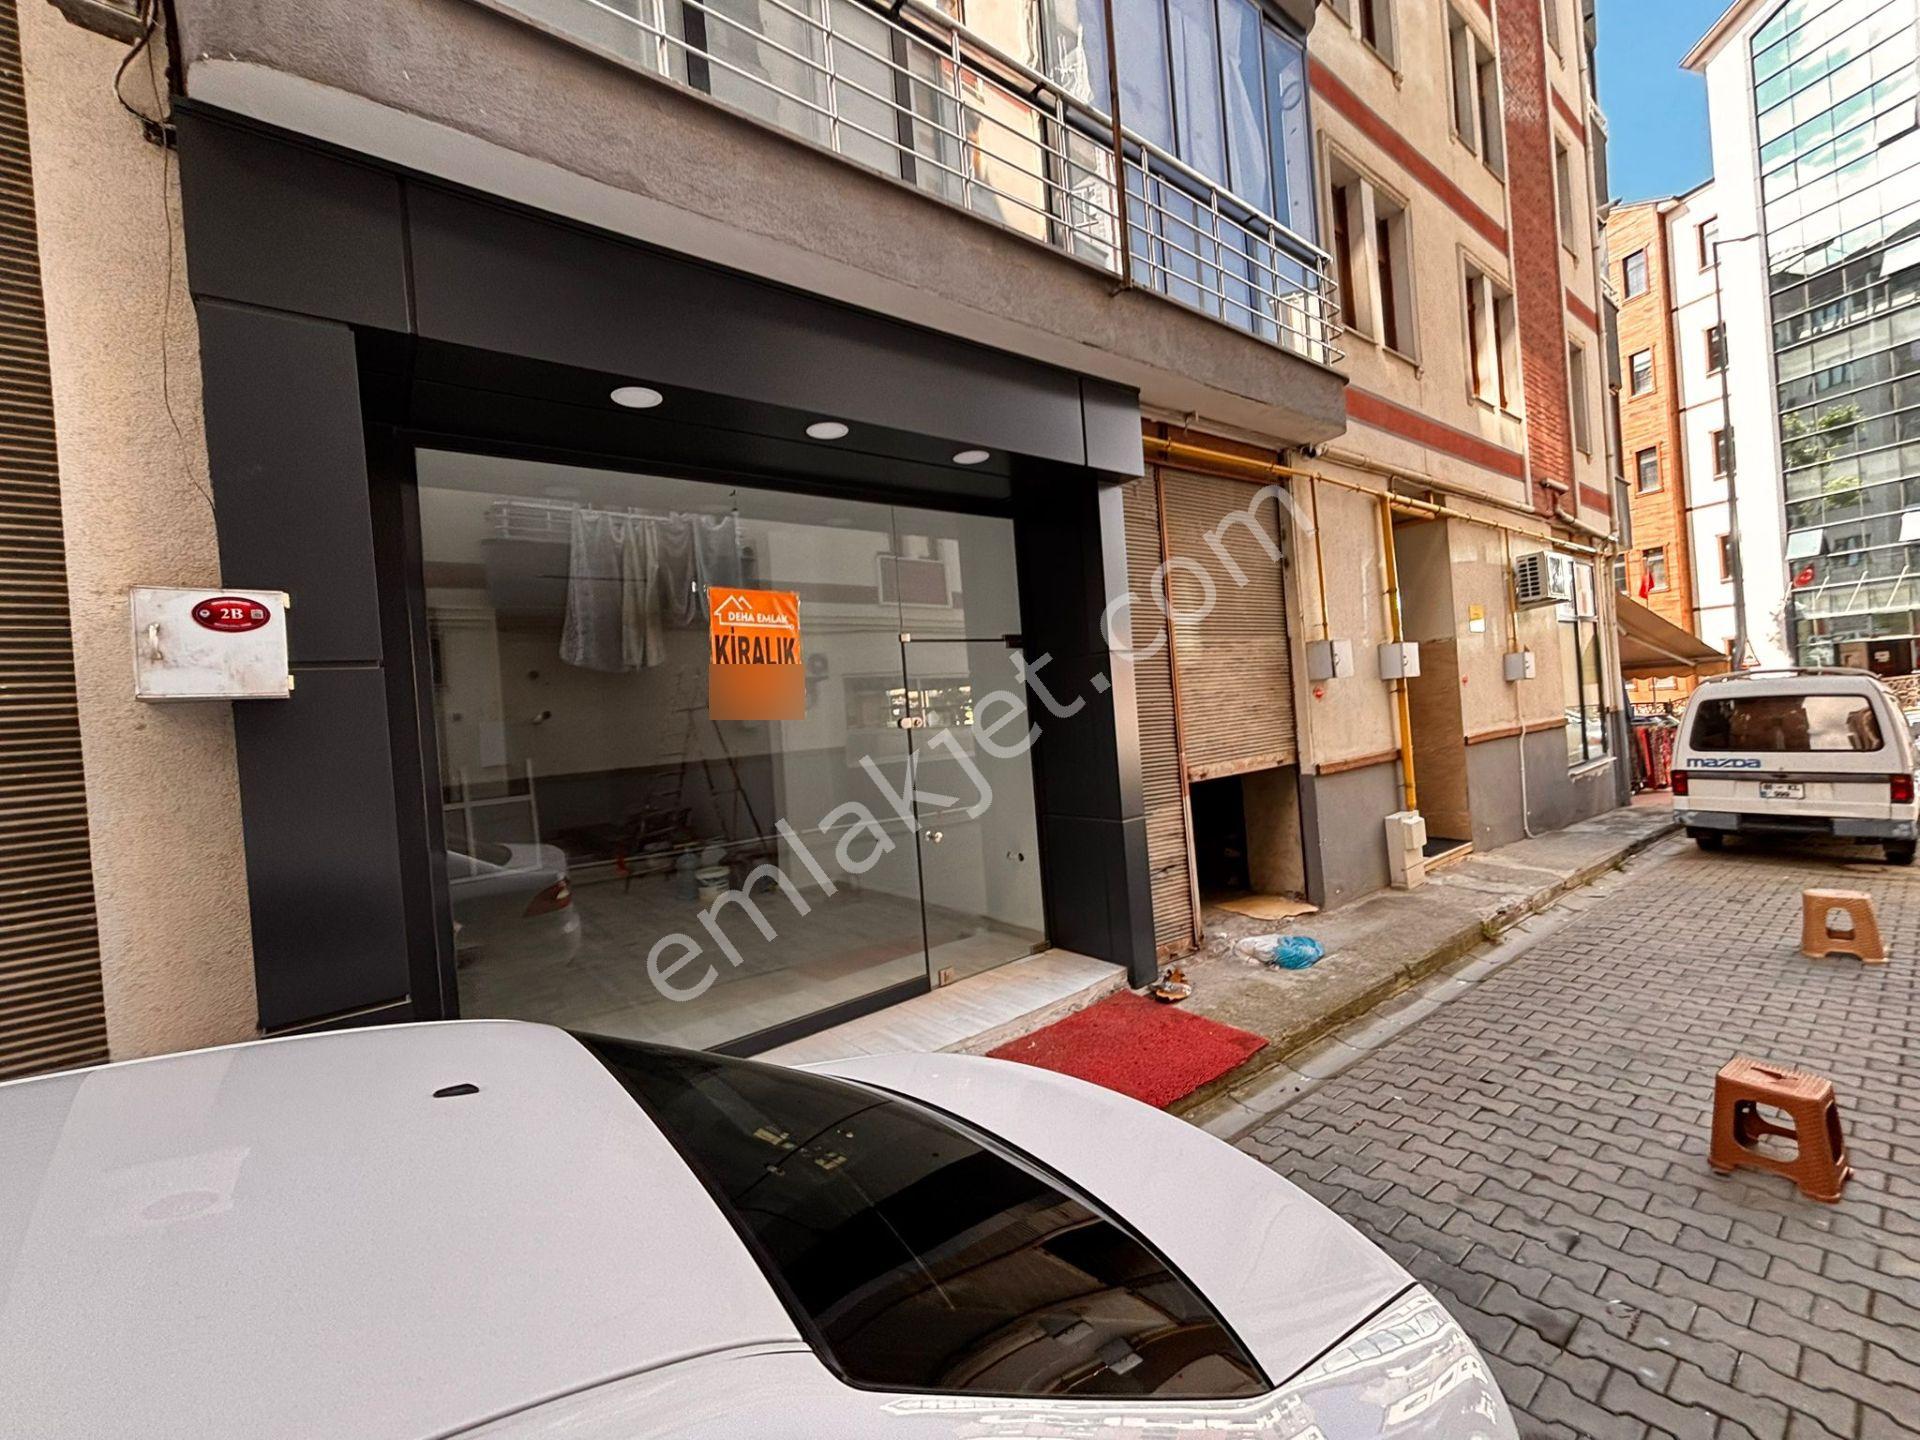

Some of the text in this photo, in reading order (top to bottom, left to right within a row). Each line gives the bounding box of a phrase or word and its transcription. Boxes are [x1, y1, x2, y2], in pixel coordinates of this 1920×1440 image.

[220, 607, 244, 620] 2B
[728, 611, 788, 623] DEHA EMLAK
[714, 627, 796, 664] KİRALIK
[1686, 758, 1761, 768] mazda
